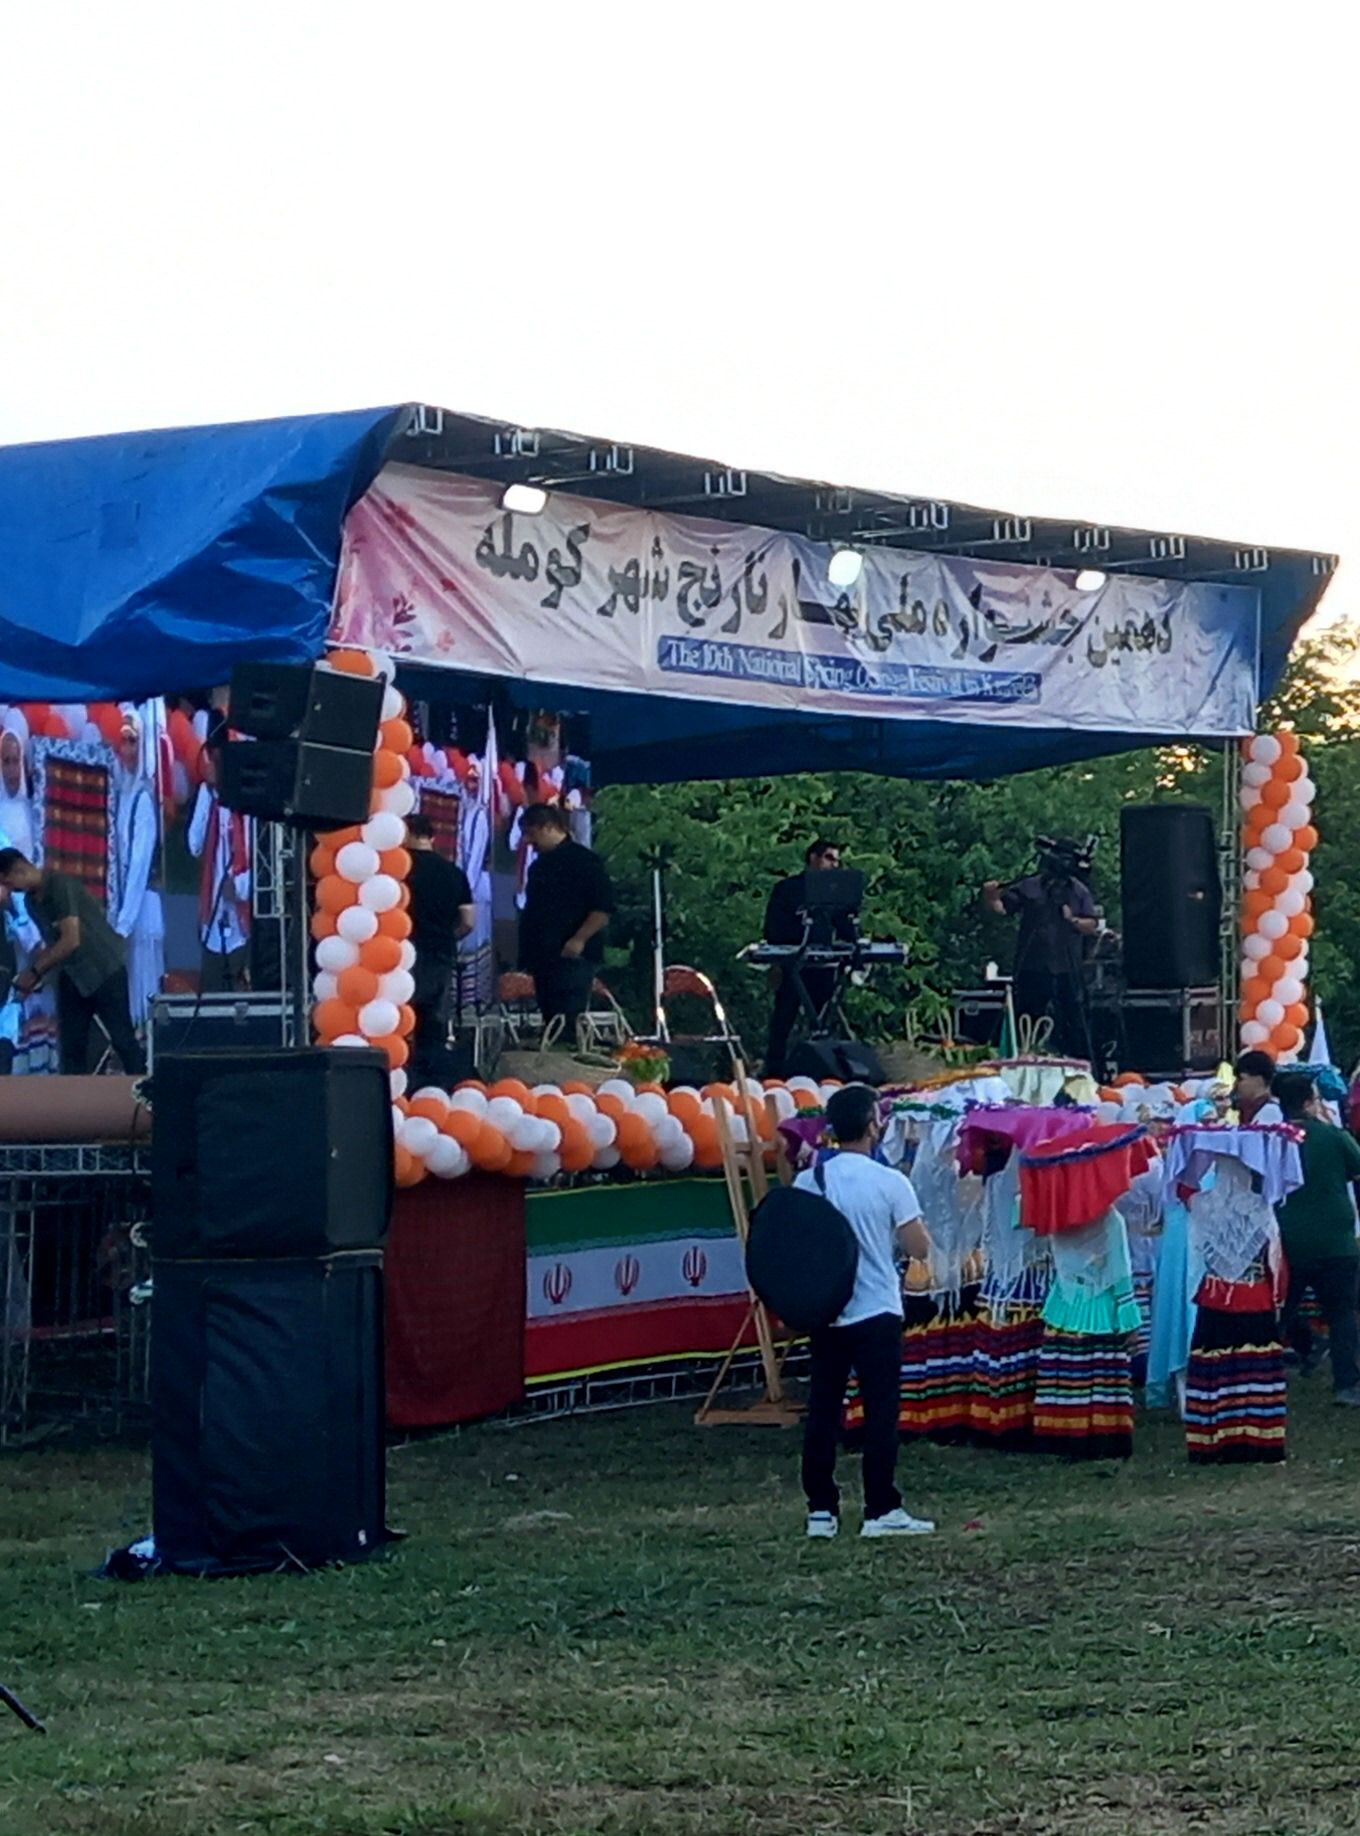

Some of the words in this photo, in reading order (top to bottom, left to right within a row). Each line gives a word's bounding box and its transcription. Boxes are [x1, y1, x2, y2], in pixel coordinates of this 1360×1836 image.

[596, 535, 670, 618] شهر
[676, 543, 769, 634] نارنج
[666, 639, 700, 667] The
[737, 648, 801, 684] National
